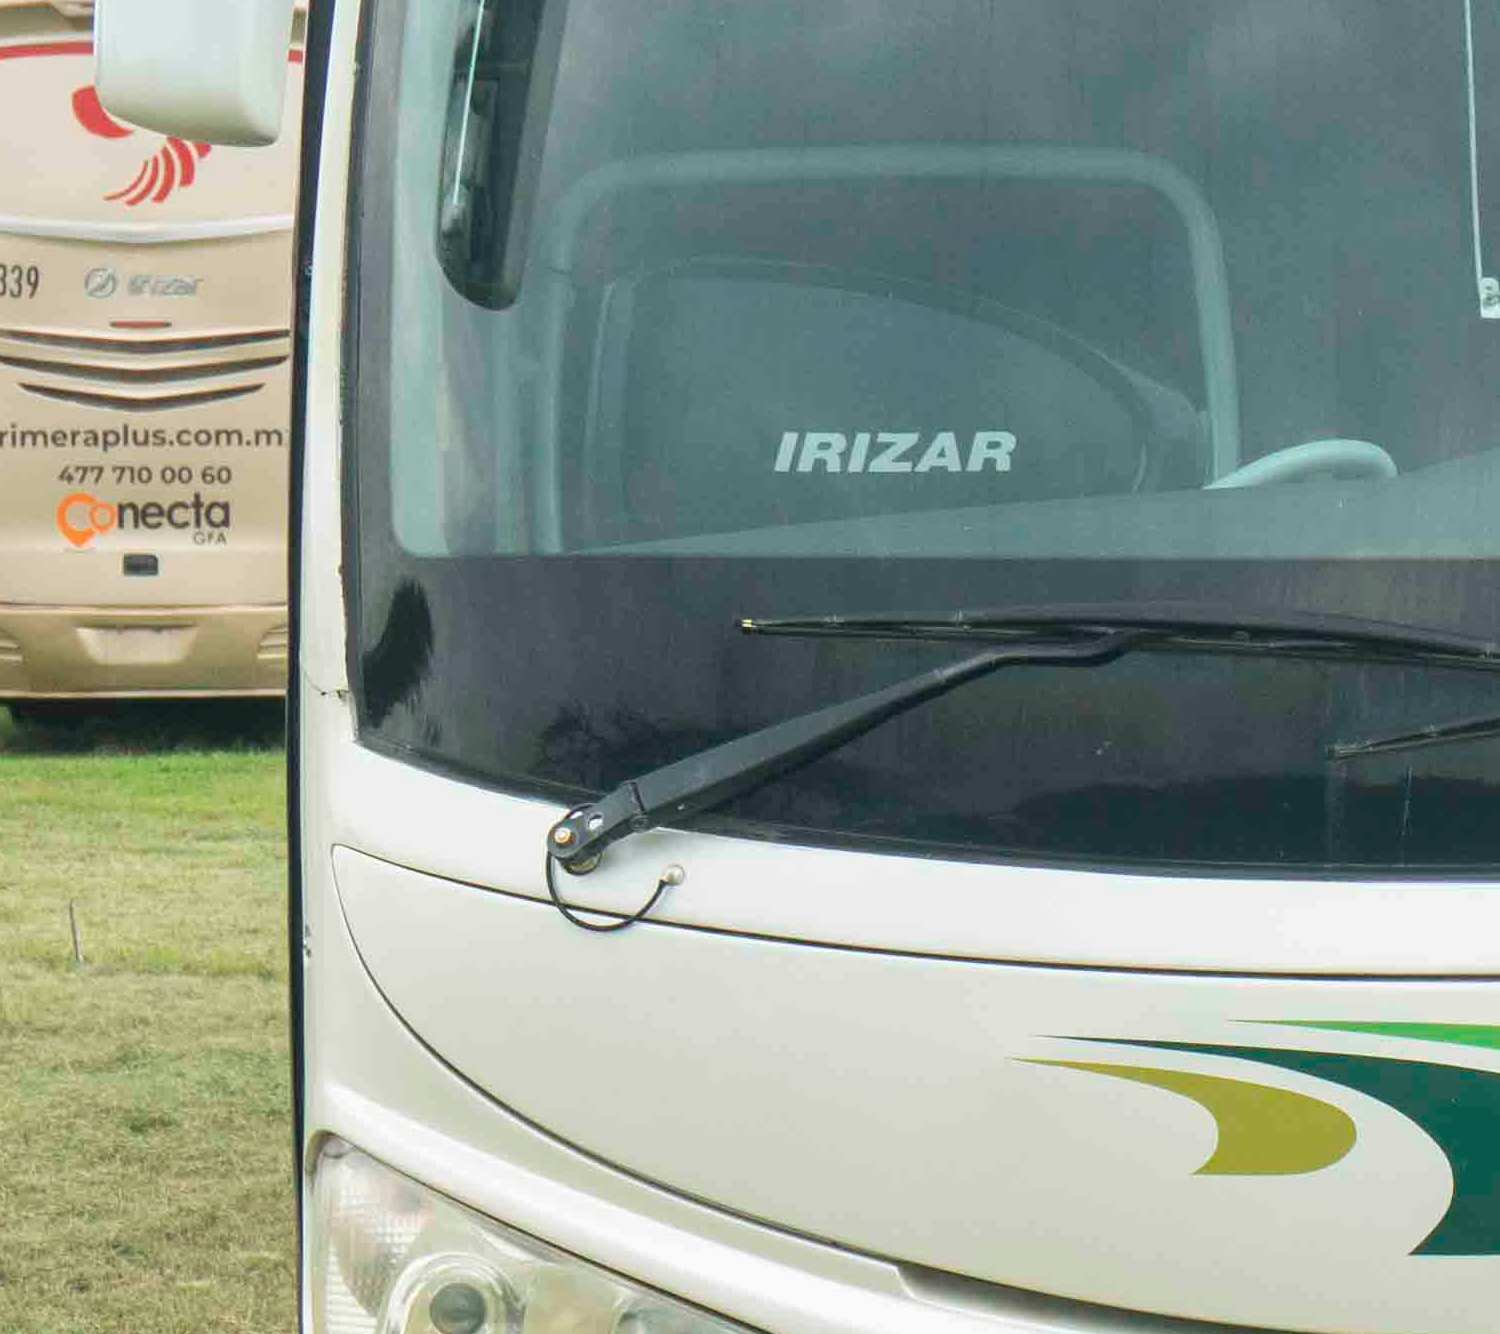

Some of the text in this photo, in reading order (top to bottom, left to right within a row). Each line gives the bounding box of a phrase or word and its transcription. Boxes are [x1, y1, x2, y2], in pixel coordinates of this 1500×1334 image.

[773, 430, 1018, 473] IRIZAR
[57, 465, 233, 486] 477 710 00 60
[192, 531, 228, 546] GFA
